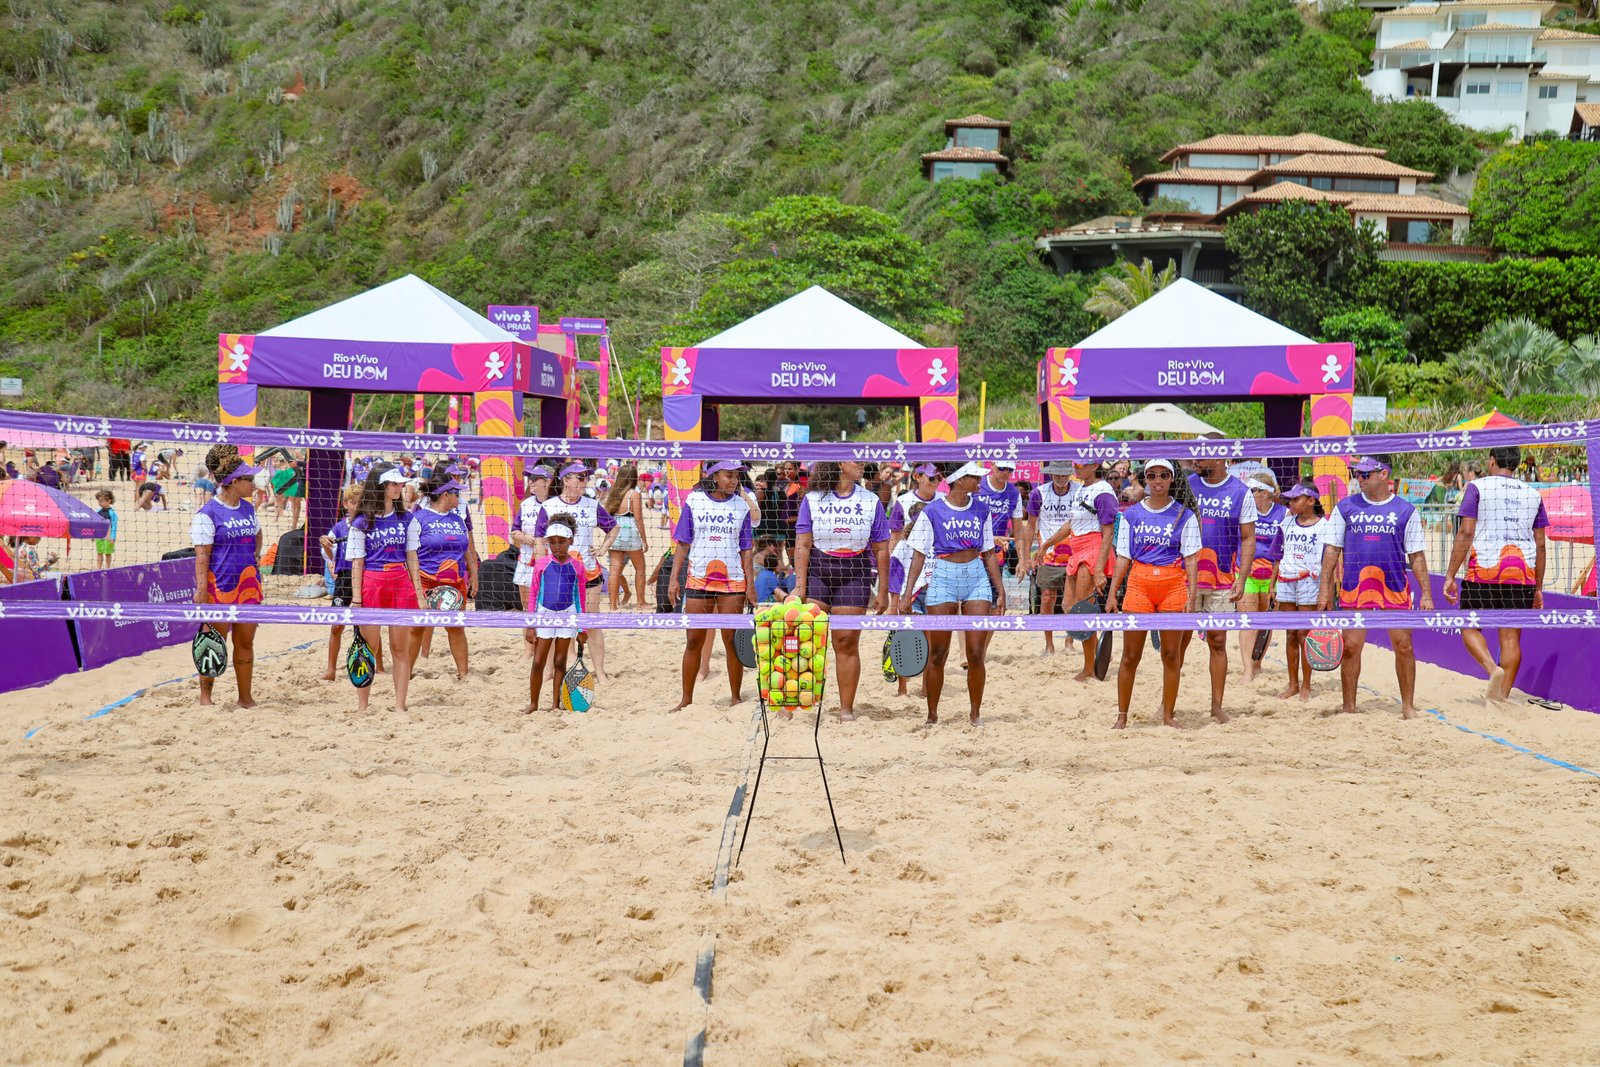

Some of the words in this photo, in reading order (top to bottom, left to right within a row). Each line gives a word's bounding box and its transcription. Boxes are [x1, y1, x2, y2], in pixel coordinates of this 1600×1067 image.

[494, 310, 521, 322] vivo
[333, 353, 378, 364] Rio+Vivo
[1168, 360, 1214, 370] Rio+Vivo
[323, 364, 351, 378] DEU
[354, 366, 388, 380] BOM
[781, 362, 826, 371] Rio+Vivo
[771, 372, 799, 387] DEU
[802, 372, 836, 387] BOM
[1158, 371, 1186, 386] DEU
[1190, 370, 1224, 385] BOM
[54, 418, 96, 433] vivo
[1532, 424, 1572, 439] vivo
[172, 426, 212, 440] vivo
[288, 431, 328, 445] vivo
[402, 436, 442, 451] vivo
[516, 440, 555, 454] vivo
[1302, 440, 1342, 454] vivo
[1416, 434, 1456, 449] vivo
[628, 443, 667, 457] vivo
[741, 444, 780, 458] vivo
[853, 446, 892, 459] vivo
[965, 445, 1003, 458] vivo
[1076, 444, 1115, 458] vivo
[1189, 443, 1228, 457] vivo
[978, 496, 1001, 506] vivo
[1044, 503, 1066, 511] vivo
[819, 503, 850, 514] vivo
[1202, 508, 1230, 518] PRAIA
[224, 517, 250, 528] vivo
[428, 520, 453, 528] vivo
[698, 512, 724, 523] vivo
[834, 516, 865, 526] PRAIA
[942, 517, 971, 530] vivo
[1350, 512, 1383, 523] vivo
[241, 528, 256, 536] PRA
[367, 528, 396, 539] vivo
[710, 526, 732, 534] PRAIA
[1134, 521, 1160, 534] vivo
[1365, 526, 1395, 535] PRAIA
[1144, 536, 1170, 547] PRAIA
[1286, 531, 1307, 541] vivo
[370, 541, 382, 549] NA
[165, 588, 192, 600] GOVERNO
[67, 603, 107, 618] vivo
[183, 606, 224, 622] vivo
[298, 609, 338, 623] vivo
[412, 611, 451, 625] vivo
[525, 616, 563, 627] vivo
[636, 616, 675, 627] vivo
[860, 617, 899, 629] vivo
[972, 616, 1010, 629] vivo
[1084, 616, 1123, 629] vivo
[1197, 615, 1236, 628] vivo
[1310, 614, 1350, 627] vivo
[1424, 613, 1464, 626] vivo
[1539, 610, 1580, 626] vivo
